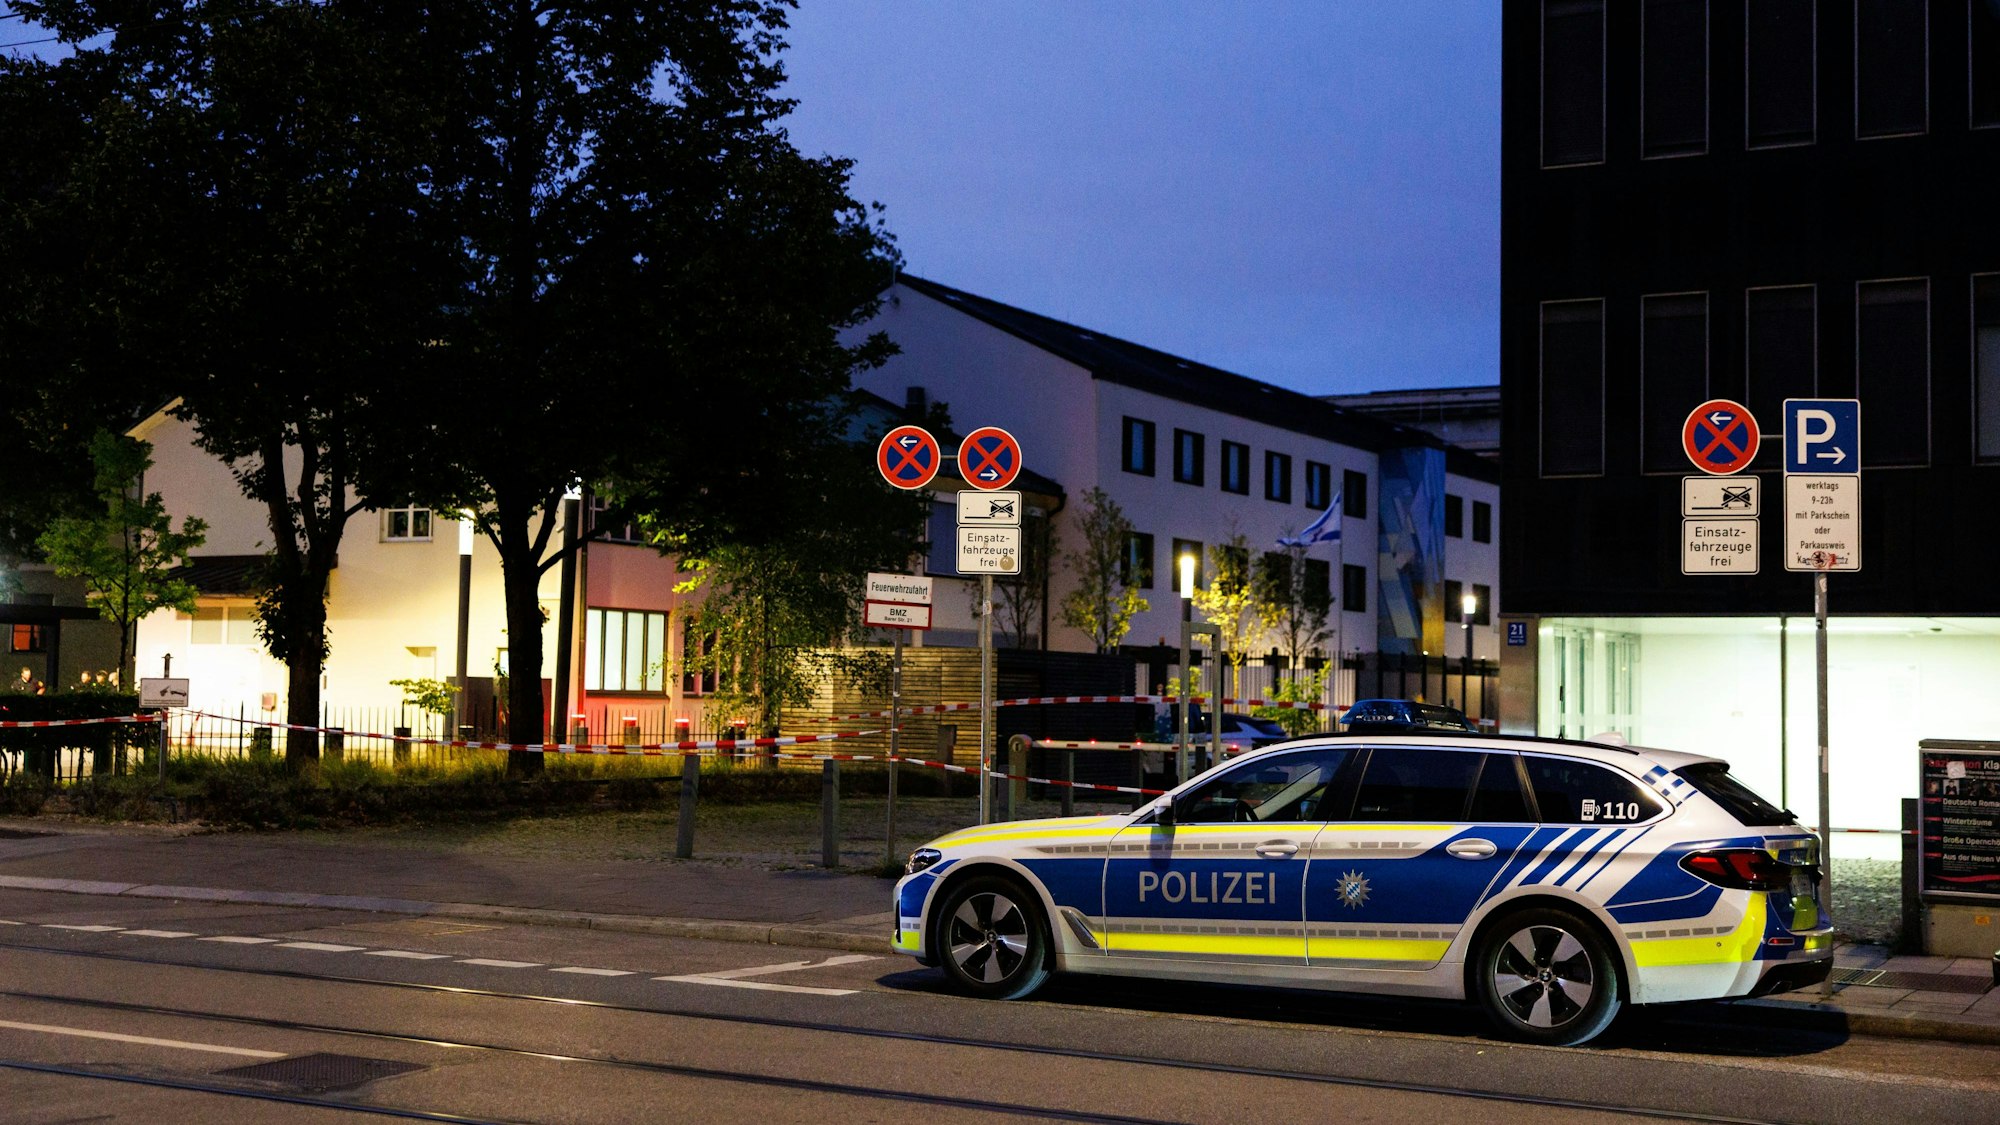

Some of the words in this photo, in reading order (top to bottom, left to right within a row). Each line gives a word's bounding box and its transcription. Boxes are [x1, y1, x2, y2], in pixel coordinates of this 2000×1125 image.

[1797, 409, 1837, 465] P
[1806, 481, 1839, 491] werktags
[1811, 496, 1833, 505] 9-23h
[1795, 511, 1808, 520] mit
[1810, 511, 1850, 520] Parkschein
[1695, 527, 1746, 537] Einsatz-
[1814, 526, 1831, 535] oder
[967, 532, 1010, 543] Einsatz-
[1689, 542, 1752, 552] fahrzeuge
[1800, 541, 1845, 550] Parkausweis
[962, 545, 1015, 558] fahrzeuge
[980, 557, 998, 567] frei
[1710, 557, 1731, 567] frei
[871, 581, 928, 596] Feuerwehrzufahrt
[889, 608, 907, 617] BMZ
[1510, 624, 1524, 635] 21
[1943, 798, 1977, 807] Deutsche
[1603, 802, 1639, 820] 110
[1943, 817, 1993, 827] Winterträume
[1943, 853, 1956, 861] Aus
[1957, 853, 1970, 861] der
[1971, 855, 1995, 863] Neuen
[1138, 871, 1276, 904] POLIZEI
